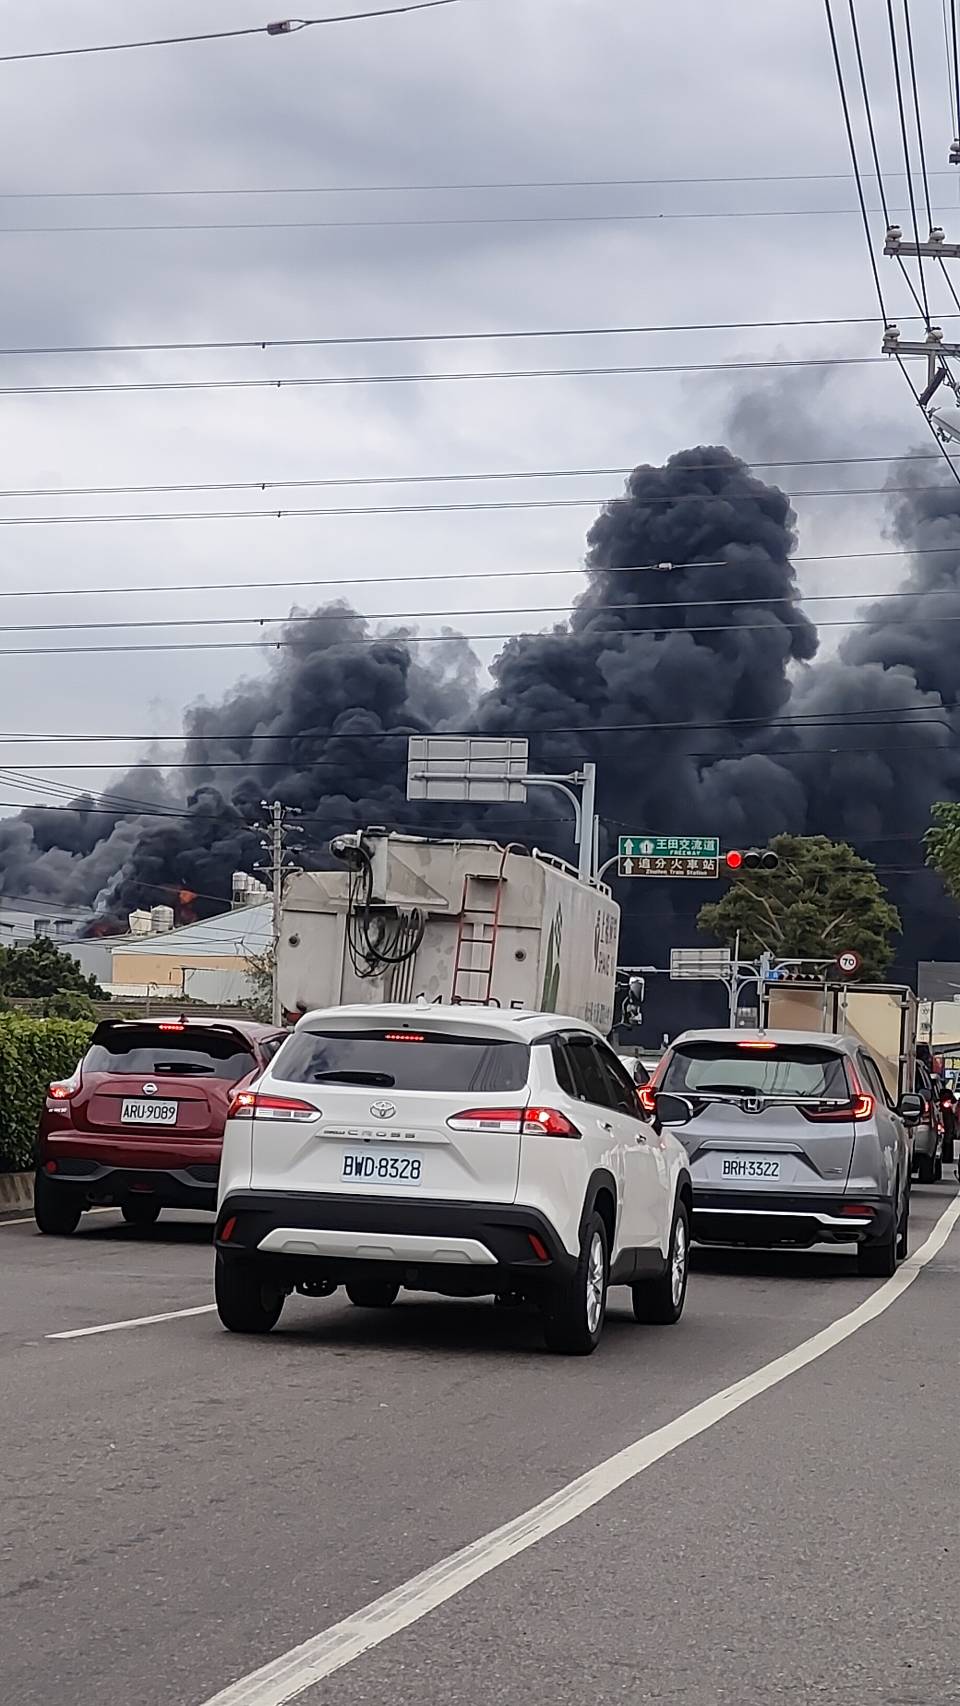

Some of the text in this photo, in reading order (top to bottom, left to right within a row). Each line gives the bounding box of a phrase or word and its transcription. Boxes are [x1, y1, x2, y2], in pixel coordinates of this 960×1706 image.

[656, 839, 715, 851] 王田交流道
[638, 858, 715, 870] 追分火車站
[842, 957, 855, 967] 70
[347, 1129, 416, 1139] CROSS
